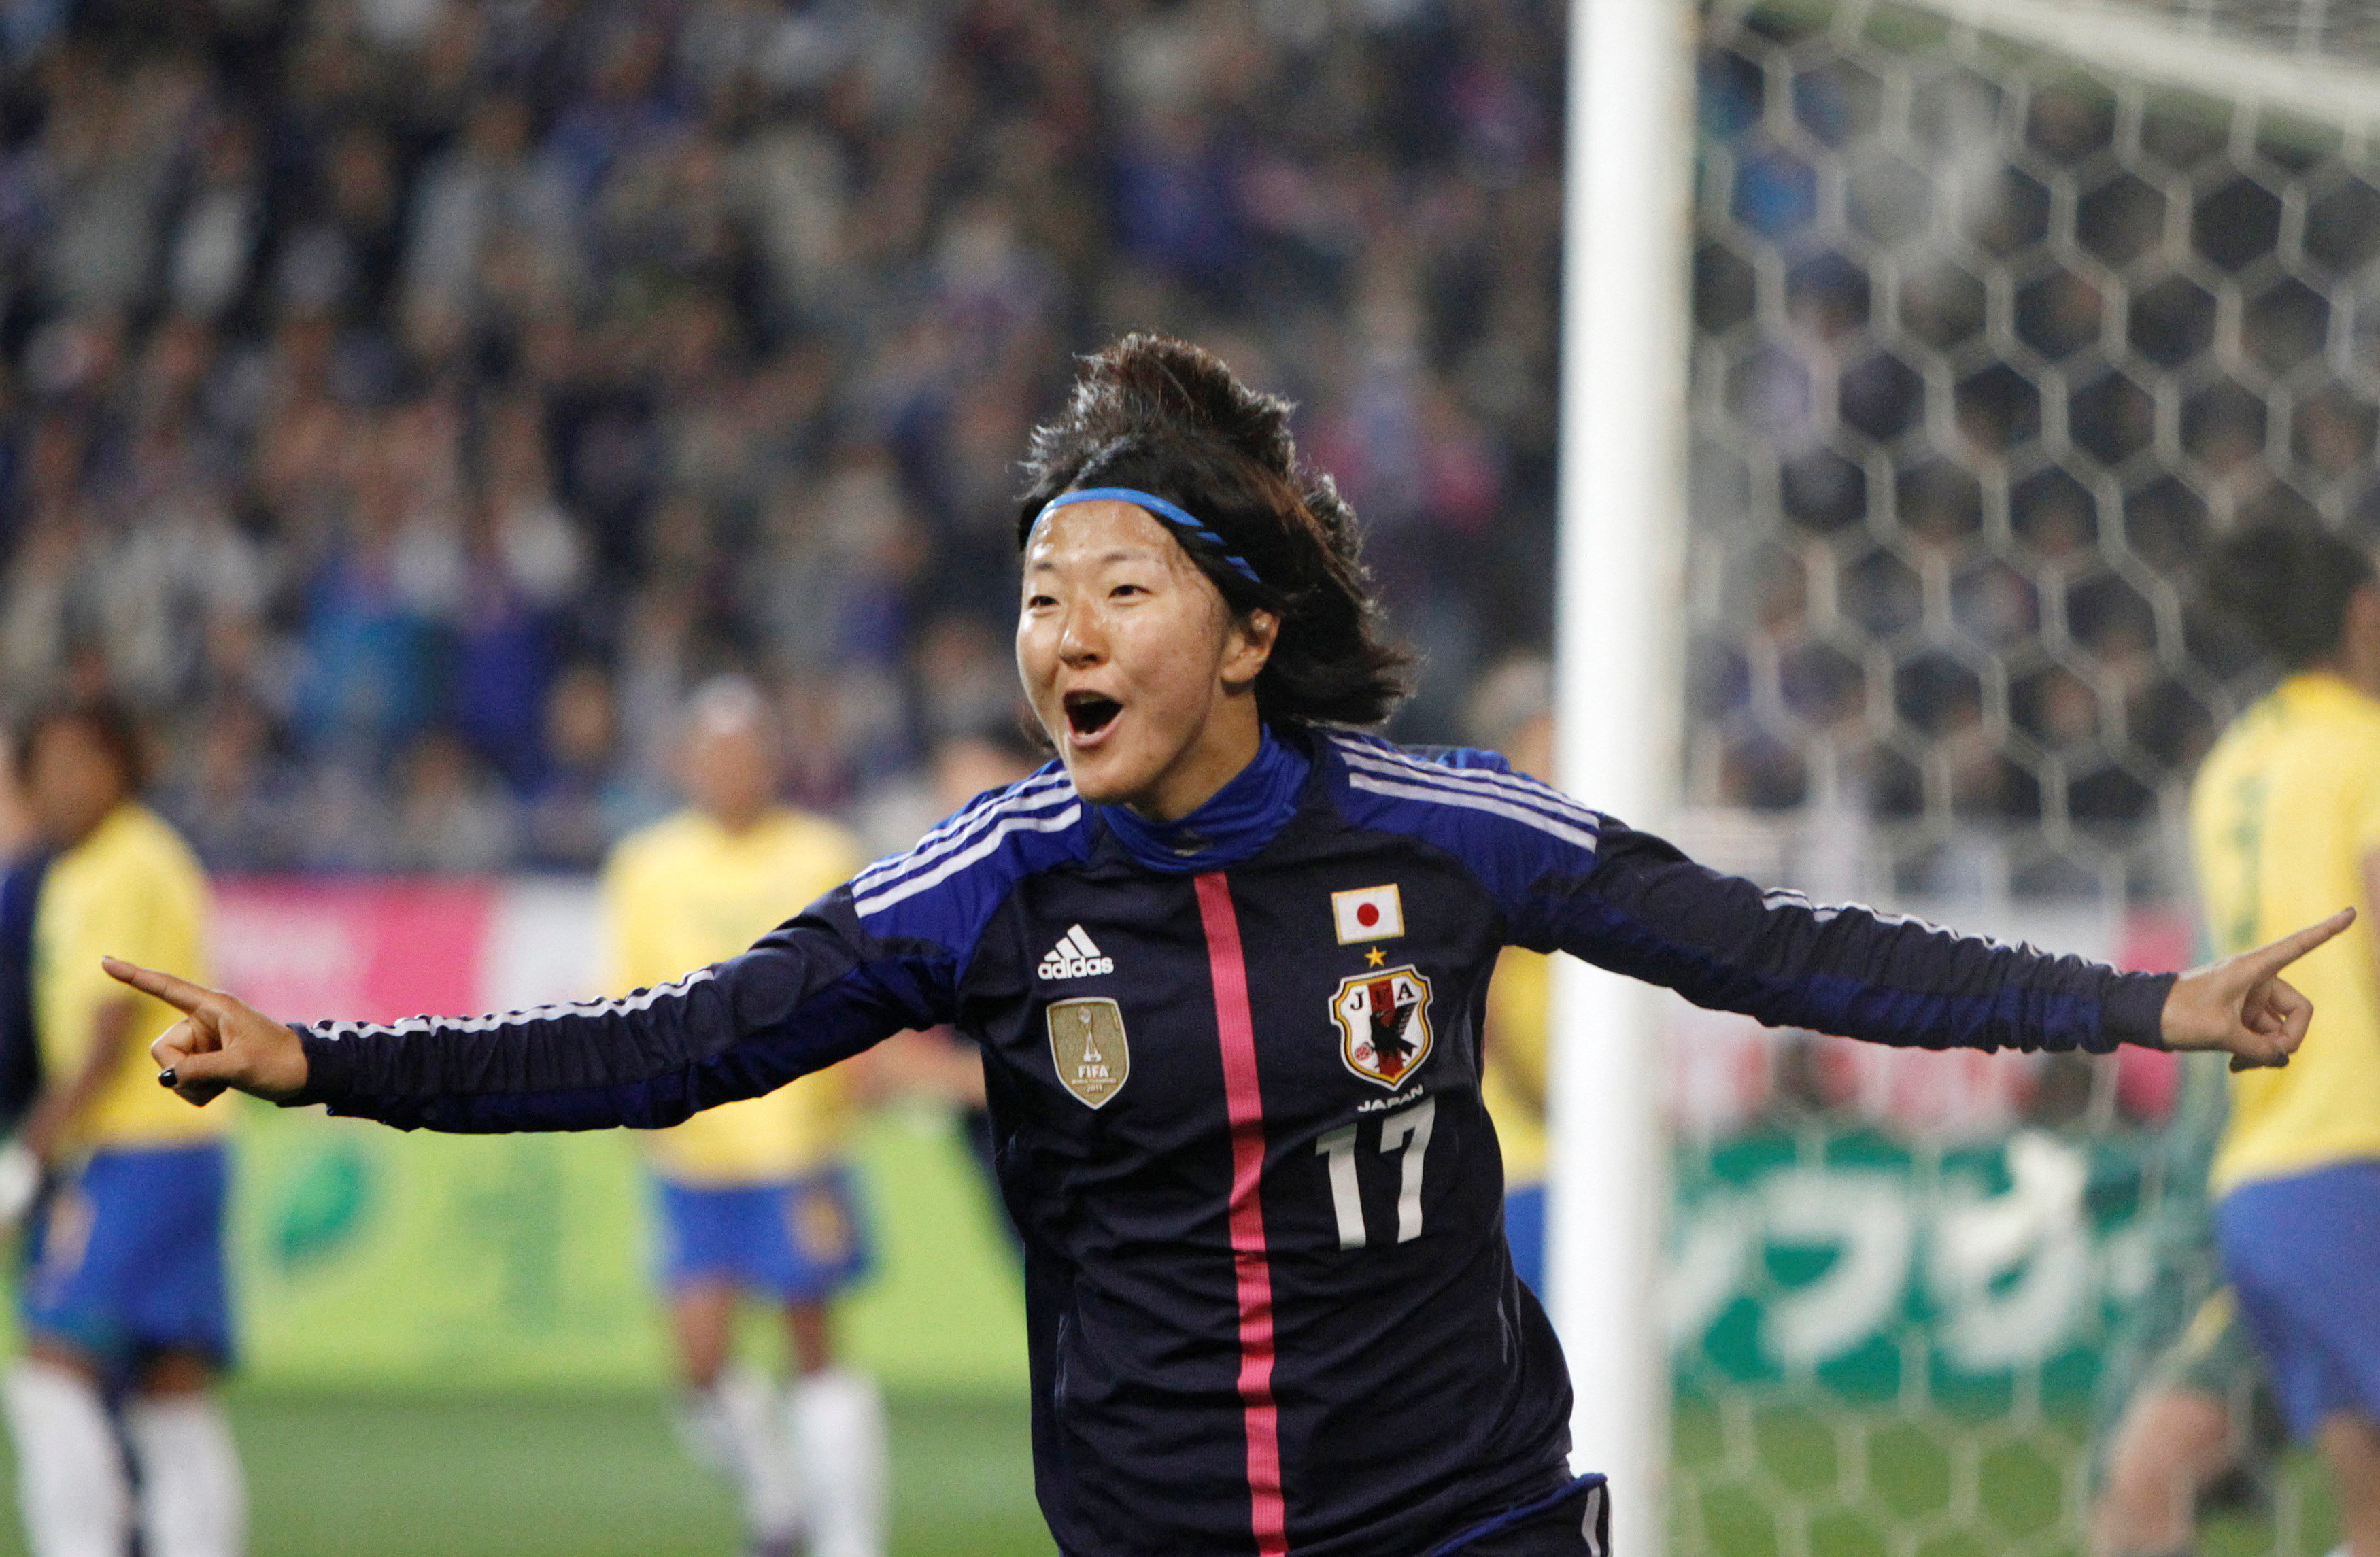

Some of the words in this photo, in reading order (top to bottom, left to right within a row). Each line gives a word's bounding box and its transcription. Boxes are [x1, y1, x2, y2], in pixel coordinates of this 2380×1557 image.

[1038, 955, 1115, 980] adidas
[1078, 1065, 1109, 1078] FIFA
[1357, 1084, 1423, 1112] JAPAN
[1315, 1094, 1436, 1252] 17
